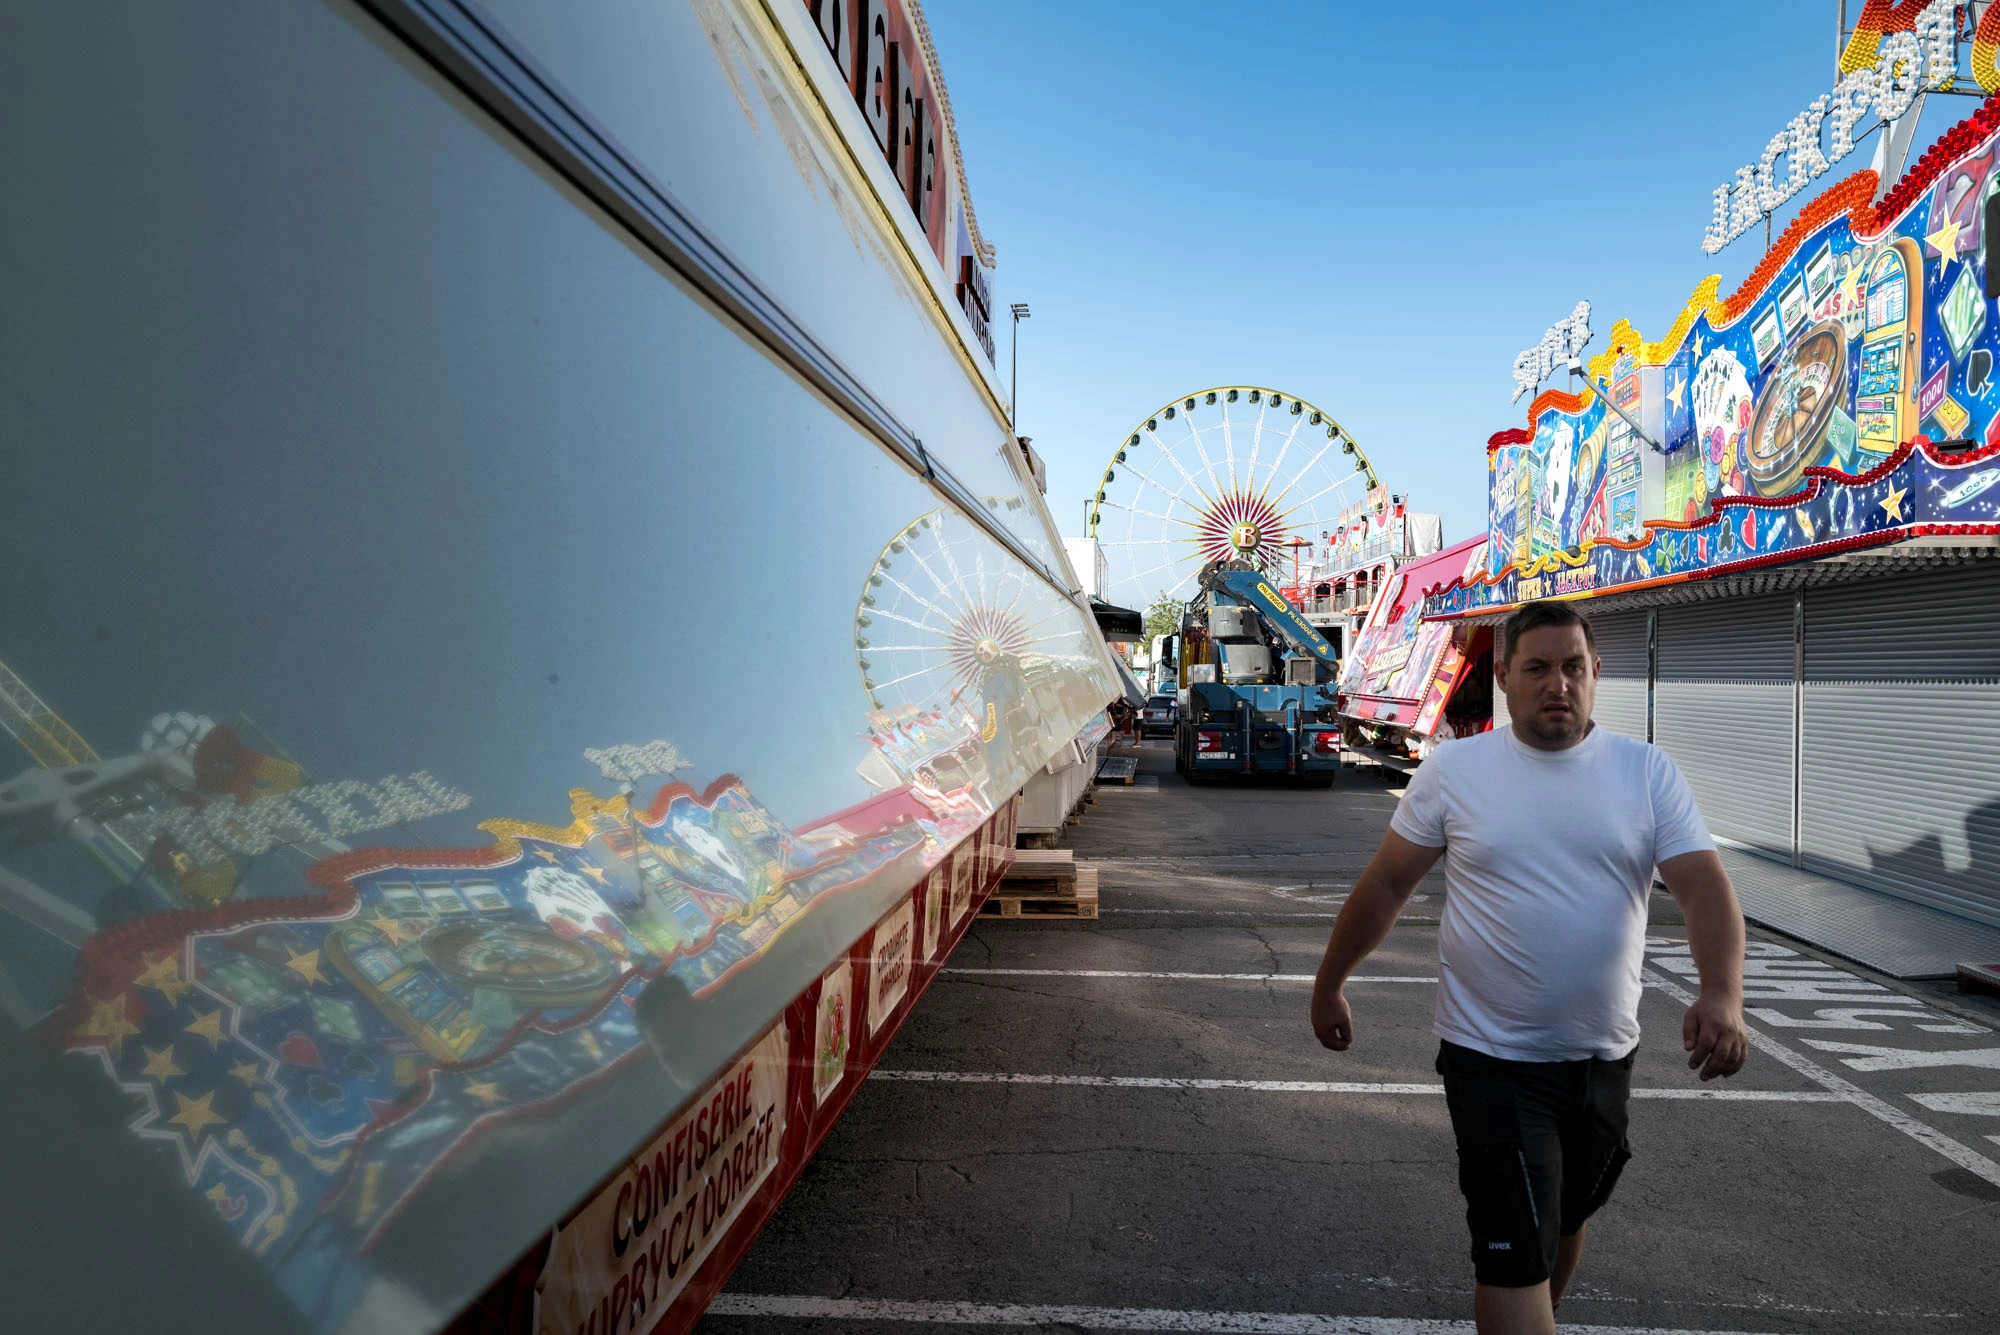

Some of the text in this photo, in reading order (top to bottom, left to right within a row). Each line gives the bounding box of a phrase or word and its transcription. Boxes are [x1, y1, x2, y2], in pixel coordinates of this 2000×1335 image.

[1702, 0, 1970, 253] JACKPOT
[1921, 379, 1943, 412] 1000
[1959, 476, 1987, 496] 1000
[1237, 527, 1257, 548] B
[1555, 565, 1597, 594] JACKPOT
[1258, 584, 1286, 611] PALFINGER
[613, 1062, 754, 1258] CONFISERIE
[578, 1103, 775, 1335] UPRYCZ DOREFF
[1488, 1241, 1512, 1250] uvex
